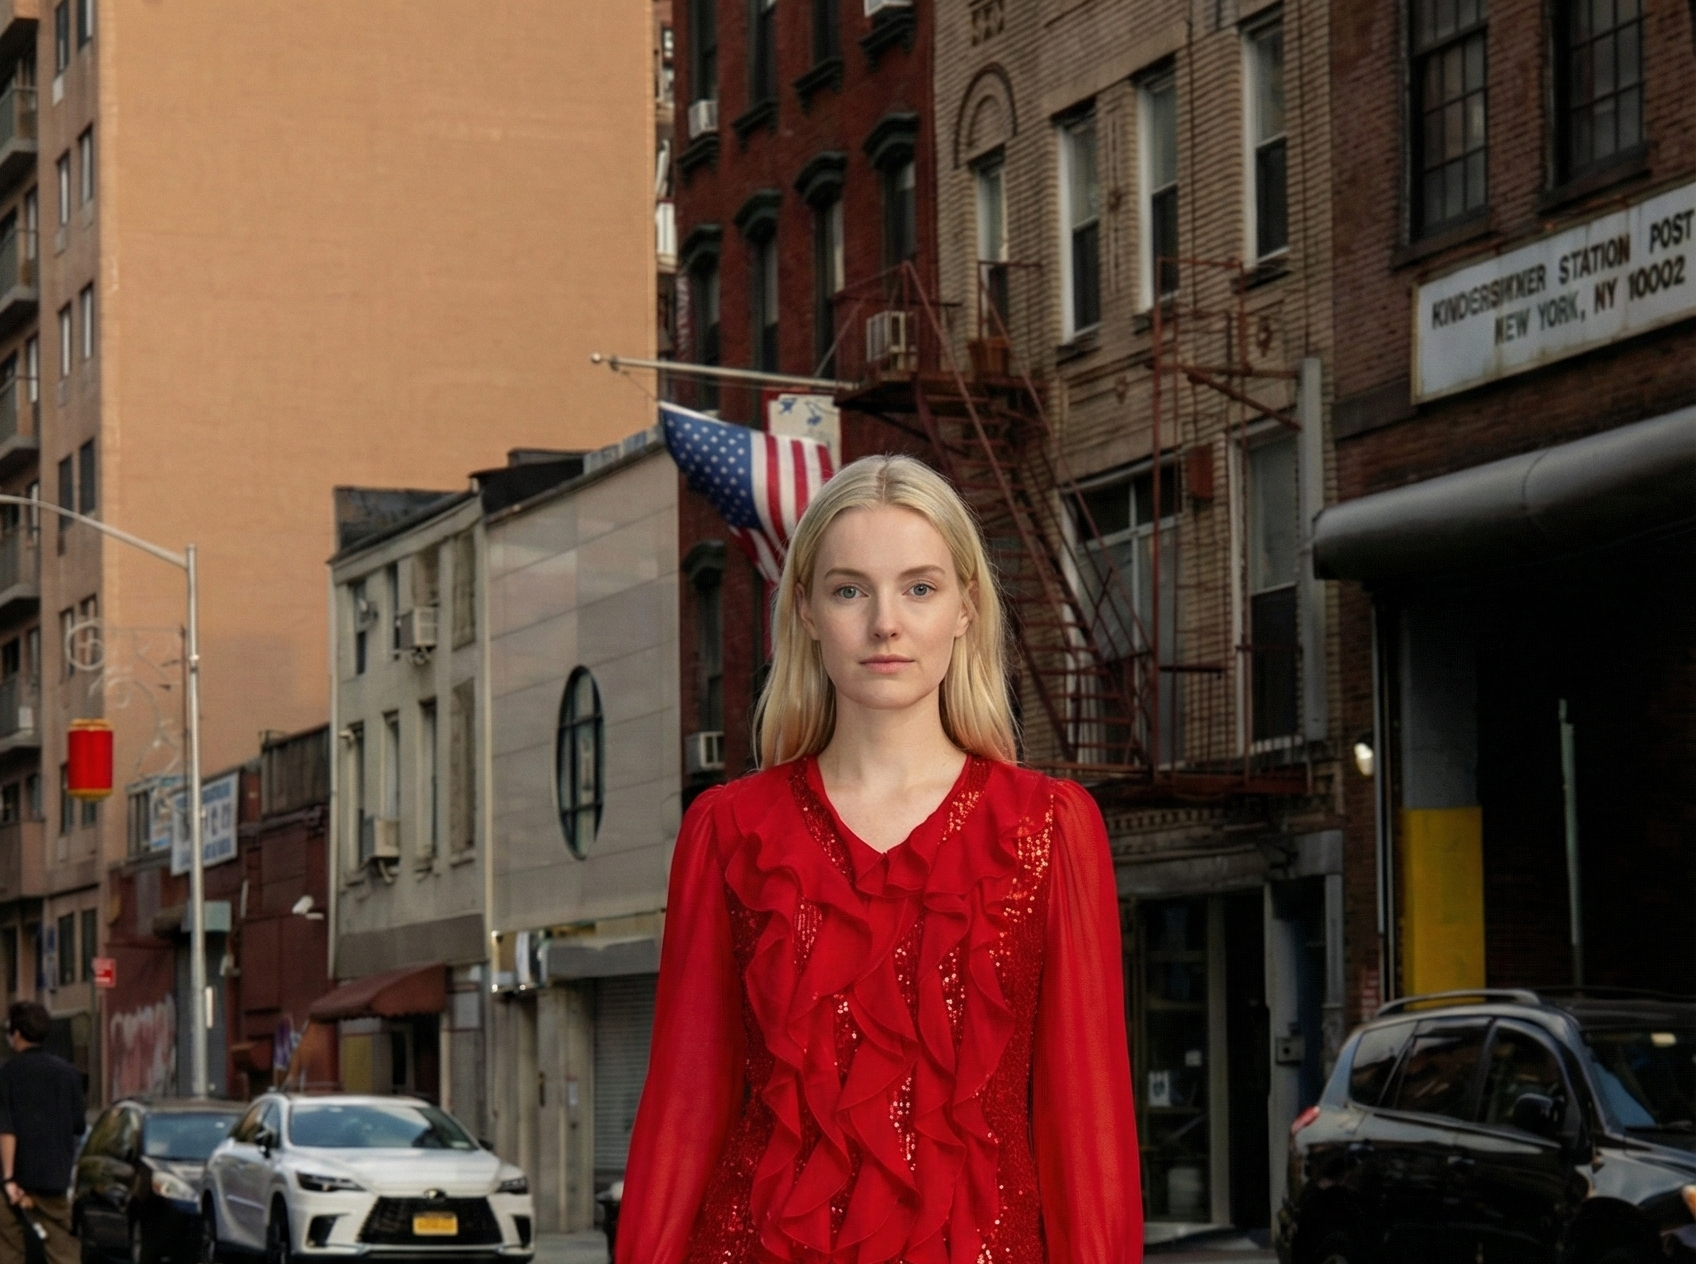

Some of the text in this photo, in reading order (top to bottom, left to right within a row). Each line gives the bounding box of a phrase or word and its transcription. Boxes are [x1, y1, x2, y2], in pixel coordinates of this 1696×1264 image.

[1559, 233, 1631, 285] STATION
[1649, 209, 1695, 254] POST
[1495, 307, 1530, 346] NEW
[1594, 278, 1618, 315] NY
[1628, 255, 1686, 301] 10002
